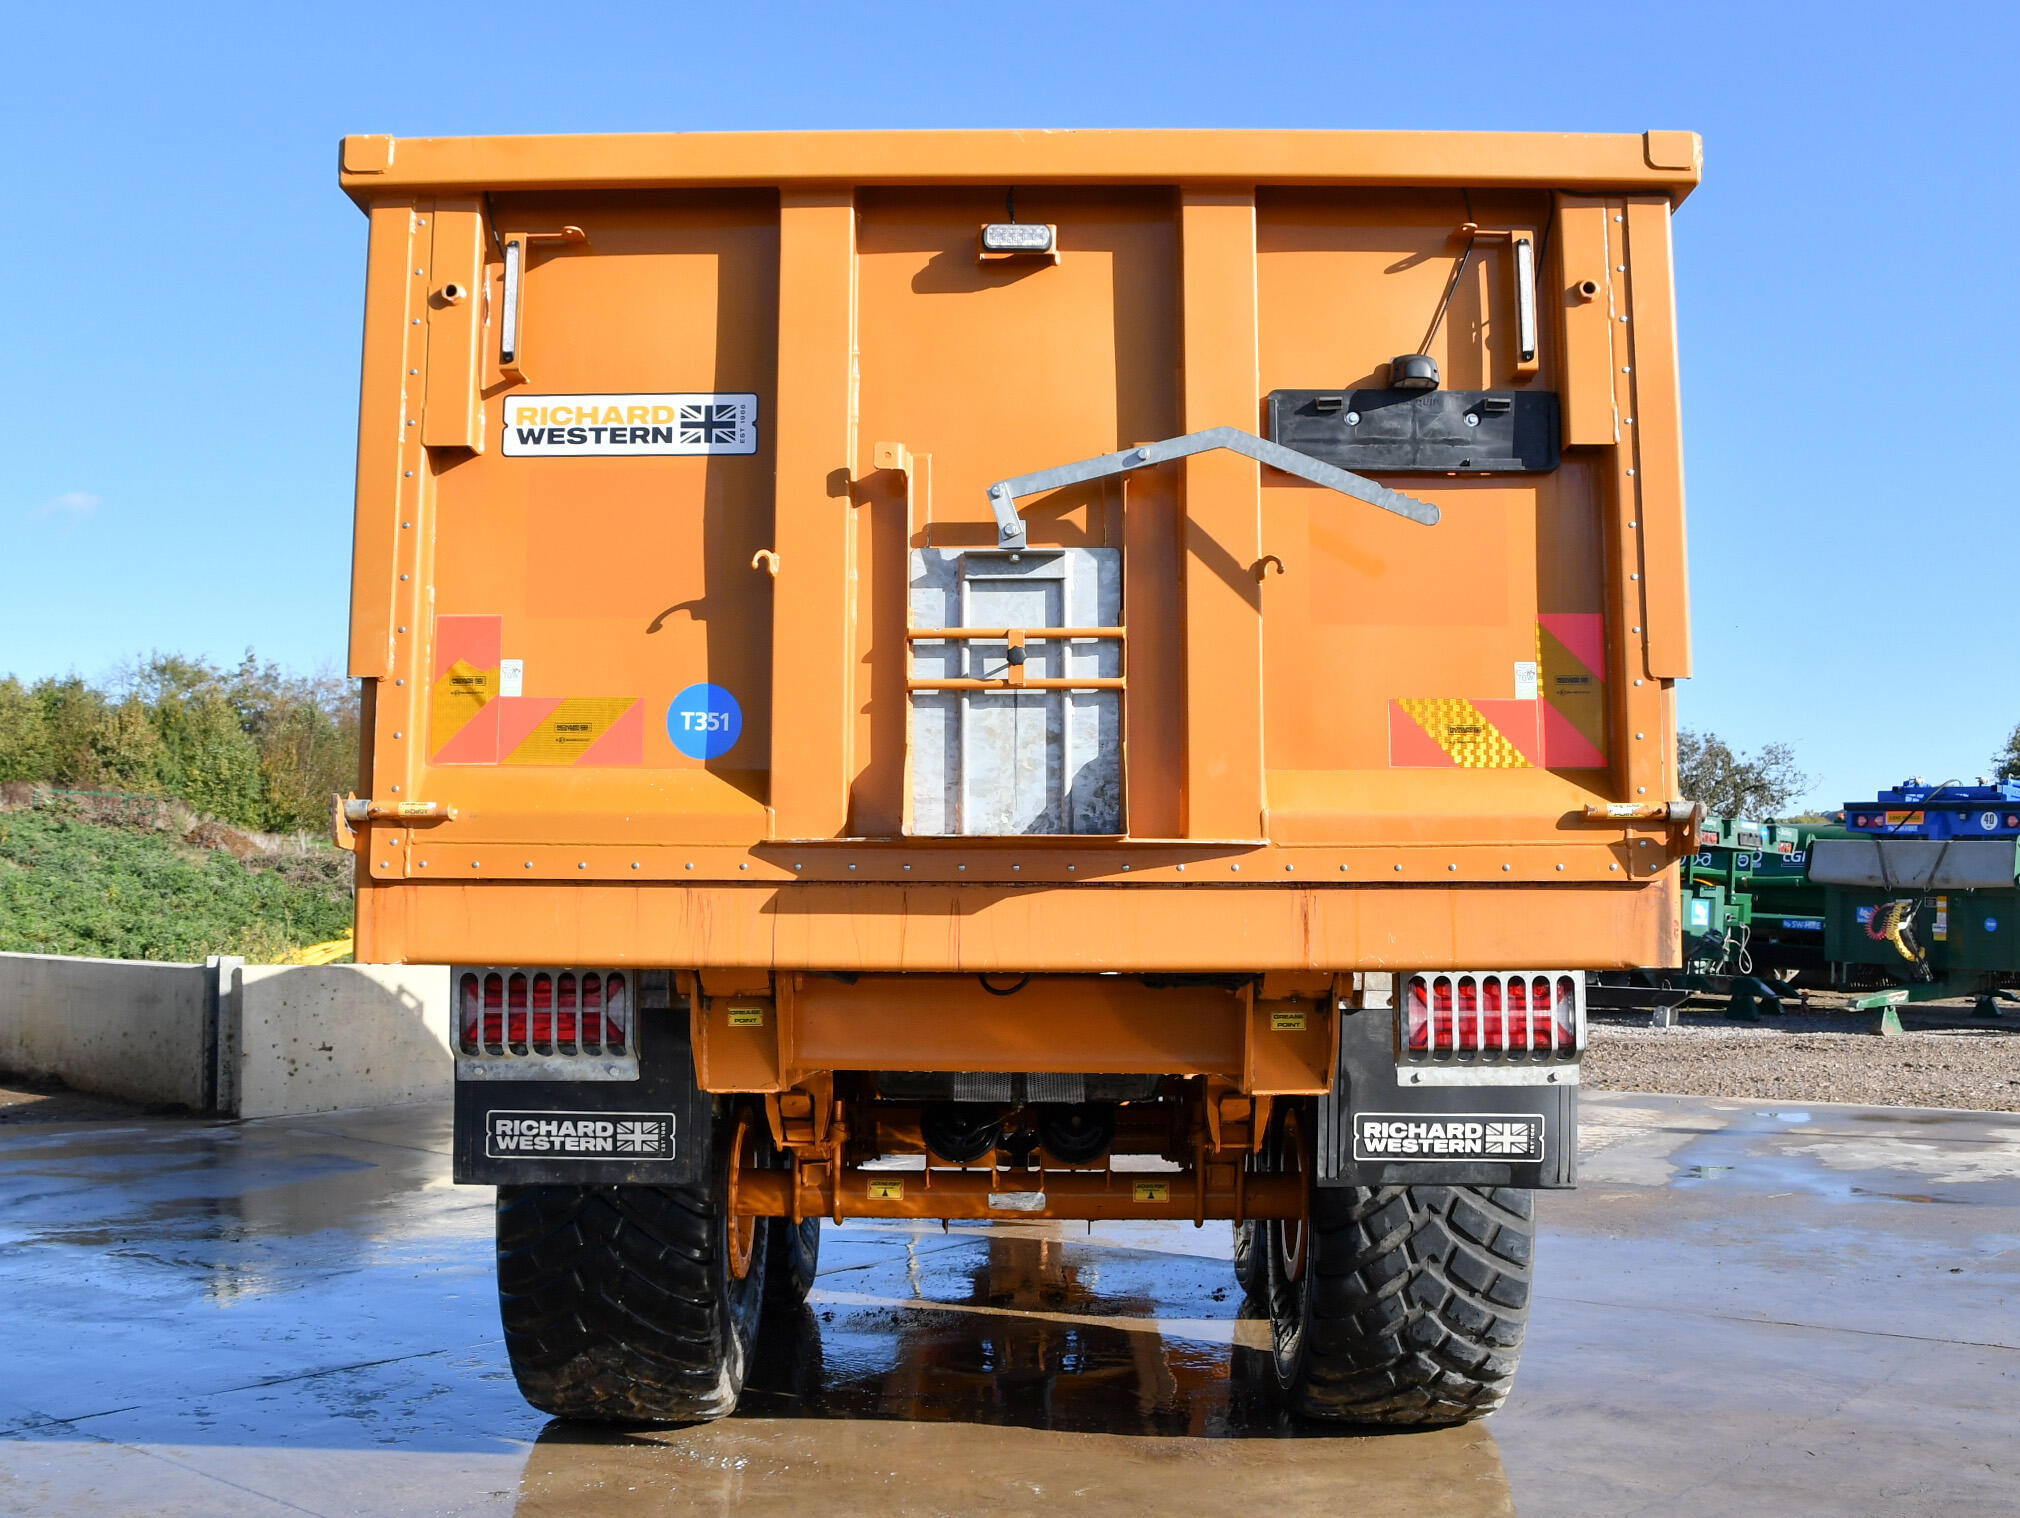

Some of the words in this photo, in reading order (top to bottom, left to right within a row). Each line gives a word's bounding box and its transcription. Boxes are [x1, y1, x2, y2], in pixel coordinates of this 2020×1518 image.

[516, 406, 675, 426] RICHARD
[516, 427, 672, 445] WESTERN
[680, 711, 729, 731] T351
[496, 1119, 614, 1137] RICHARD
[1363, 1122, 1483, 1139] RICHARD
[496, 1136, 613, 1151] WESTERN
[1364, 1138, 1482, 1153] WESTERN
